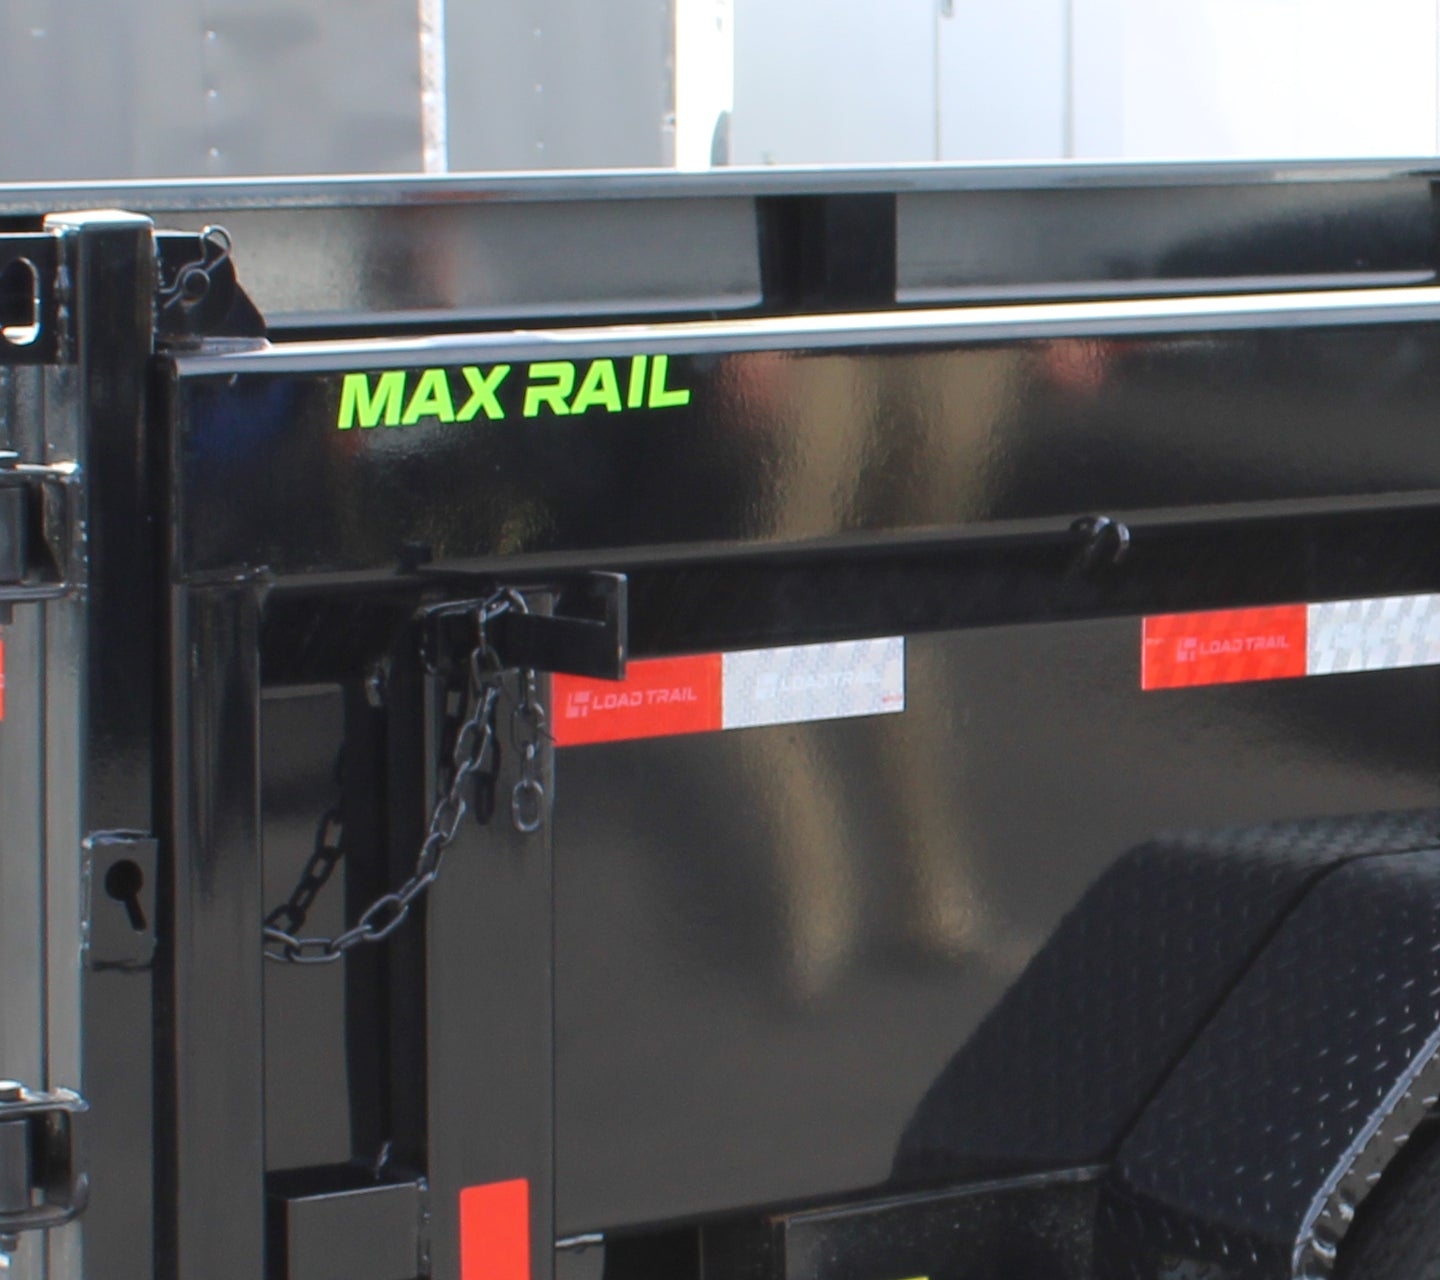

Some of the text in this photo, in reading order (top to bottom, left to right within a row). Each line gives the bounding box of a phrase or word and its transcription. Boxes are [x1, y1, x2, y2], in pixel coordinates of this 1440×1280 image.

[337, 353, 691, 430] MAX RAIL
[1200, 634, 1290, 656] LOAD TRAIL
[591, 685, 698, 711] LOAD TRAIL
